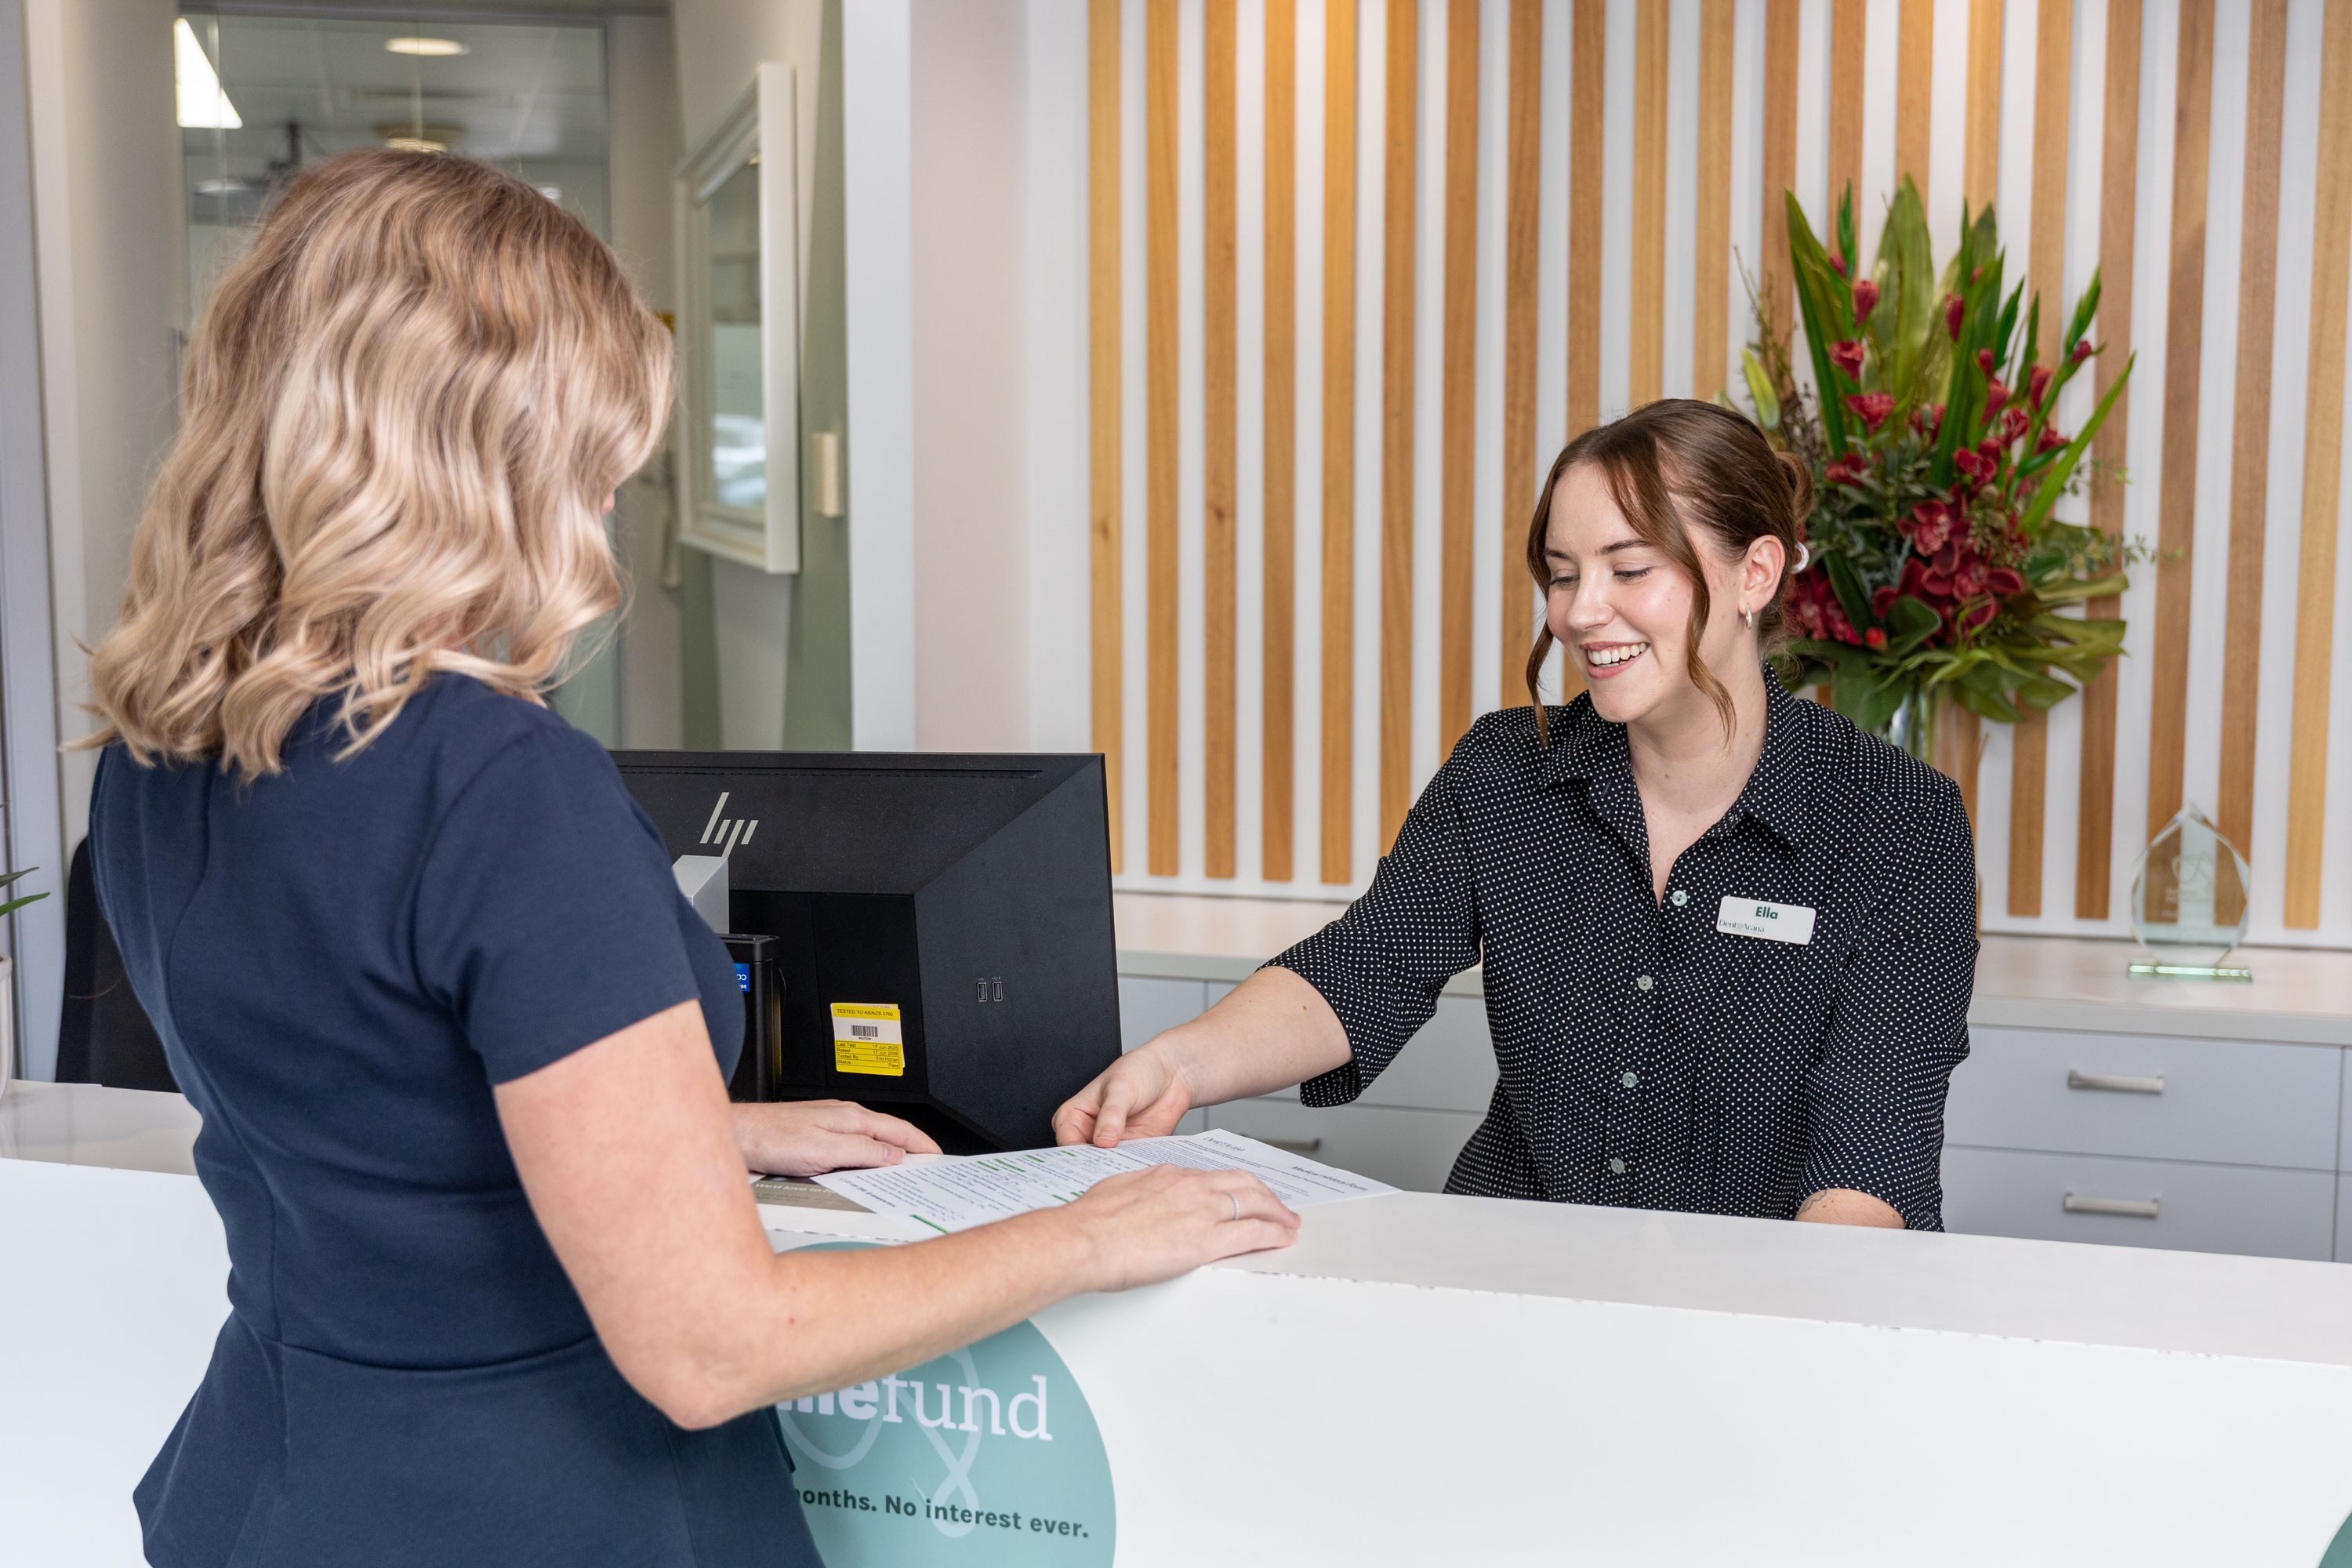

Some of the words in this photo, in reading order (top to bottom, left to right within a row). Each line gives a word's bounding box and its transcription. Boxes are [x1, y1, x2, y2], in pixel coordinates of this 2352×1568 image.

[700, 792, 759, 858] hp
[1755, 906, 1778, 920] Ella
[795, 1488, 877, 1512] onths.
[885, 1494, 916, 1517] No
[925, 1498, 1022, 1530] interest
[1029, 1516, 1089, 1538] ever.
